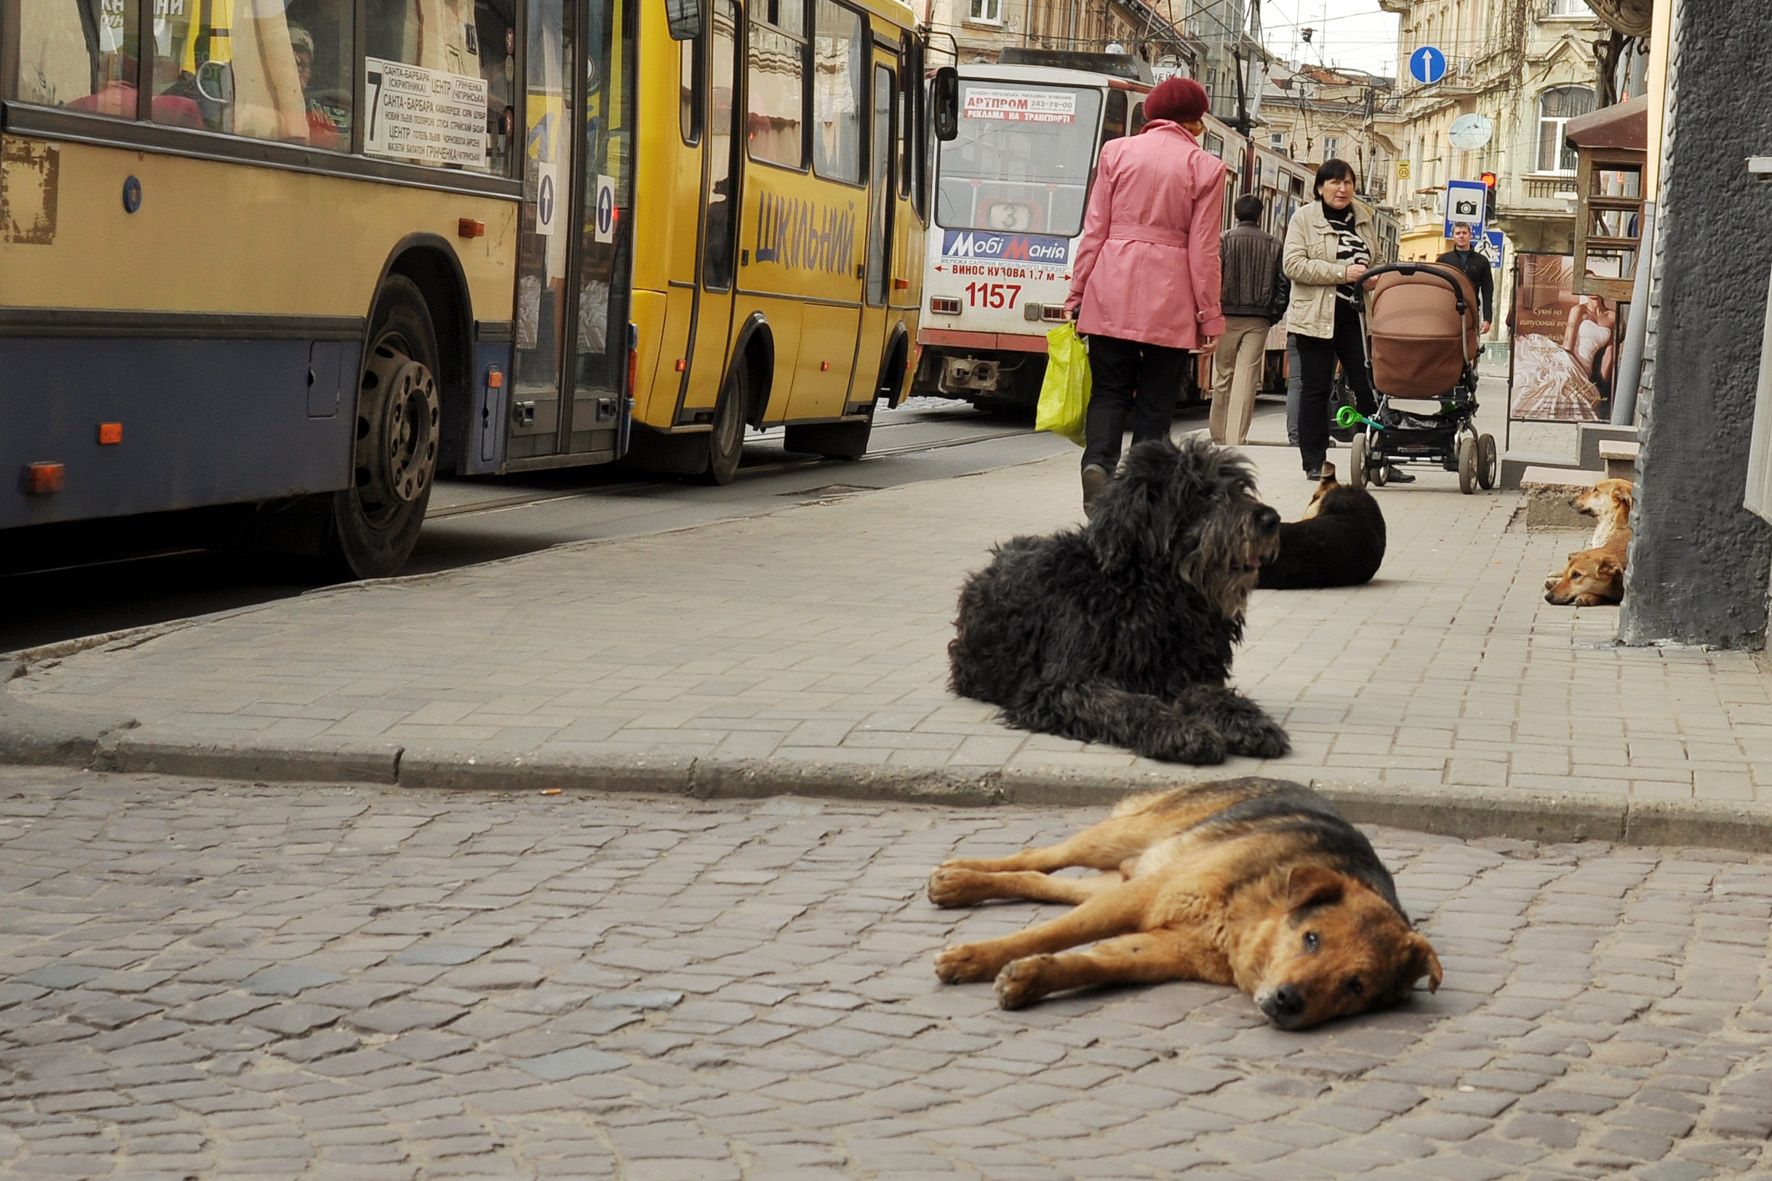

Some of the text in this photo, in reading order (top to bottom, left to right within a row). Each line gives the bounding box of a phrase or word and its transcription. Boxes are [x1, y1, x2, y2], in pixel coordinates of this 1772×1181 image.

[431, 78, 450, 98] ЦЕНТР
[368, 71, 382, 141] 7
[967, 97, 1028, 110] АРТПРОМ
[967, 109, 1004, 119] РЕКЛАМА
[1008, 112, 1019, 120] НА
[389, 124, 410, 142] ЦЕНТР
[947, 231, 1065, 261] Мобі Манія
[952, 264, 985, 276] ВИНОС
[987, 267, 1025, 278] КУЗОВА
[1029, 270, 1044, 281] 1,7
[965, 281, 1022, 310] 1157
